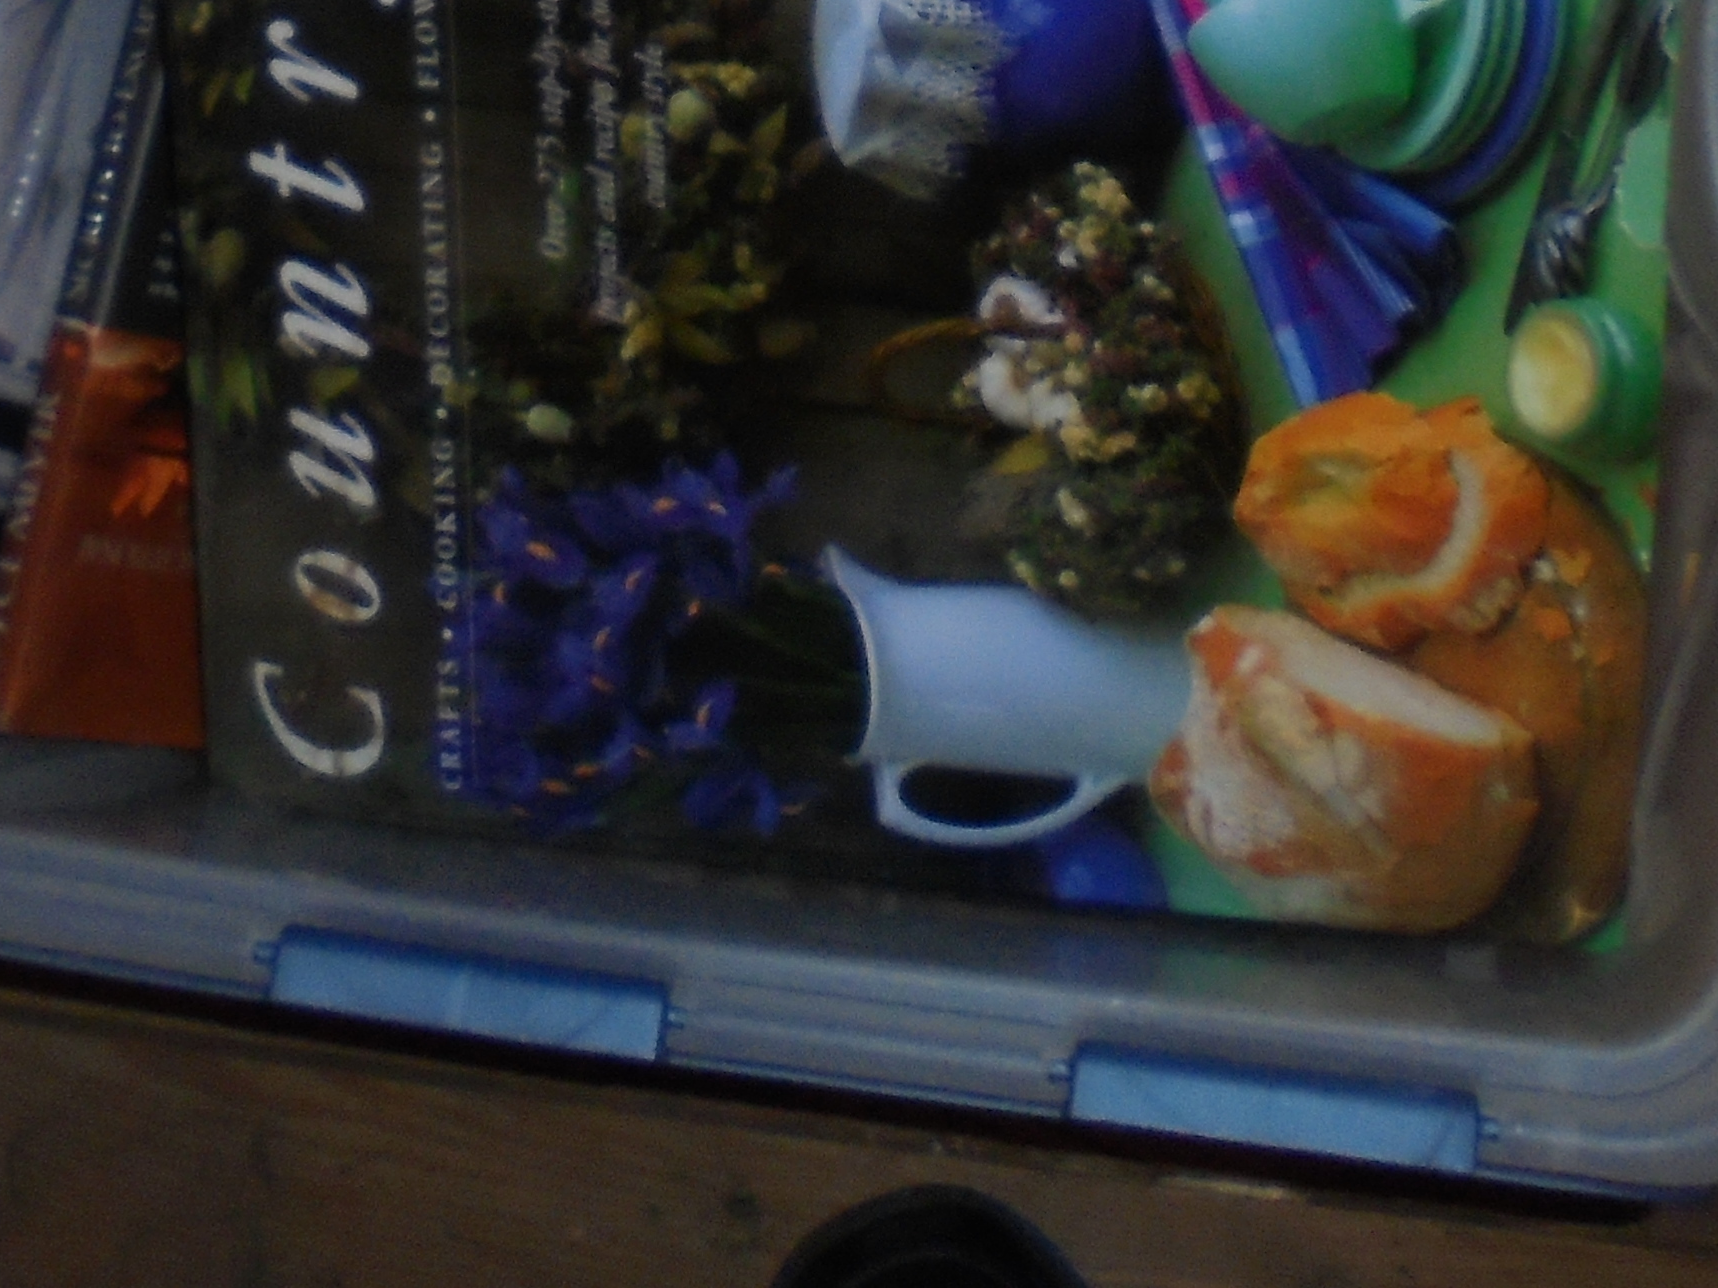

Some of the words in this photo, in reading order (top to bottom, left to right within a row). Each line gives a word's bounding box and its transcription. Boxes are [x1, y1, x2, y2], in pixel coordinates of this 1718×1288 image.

[582, 30, 621, 76] for
[632, 41, 670, 104] style
[585, 165, 618, 224] and
[535, 196, 568, 260] Over
[418, 138, 454, 390] DECORATING
[428, 436, 459, 610] COOKING
[439, 657, 462, 794] CRAFTS
